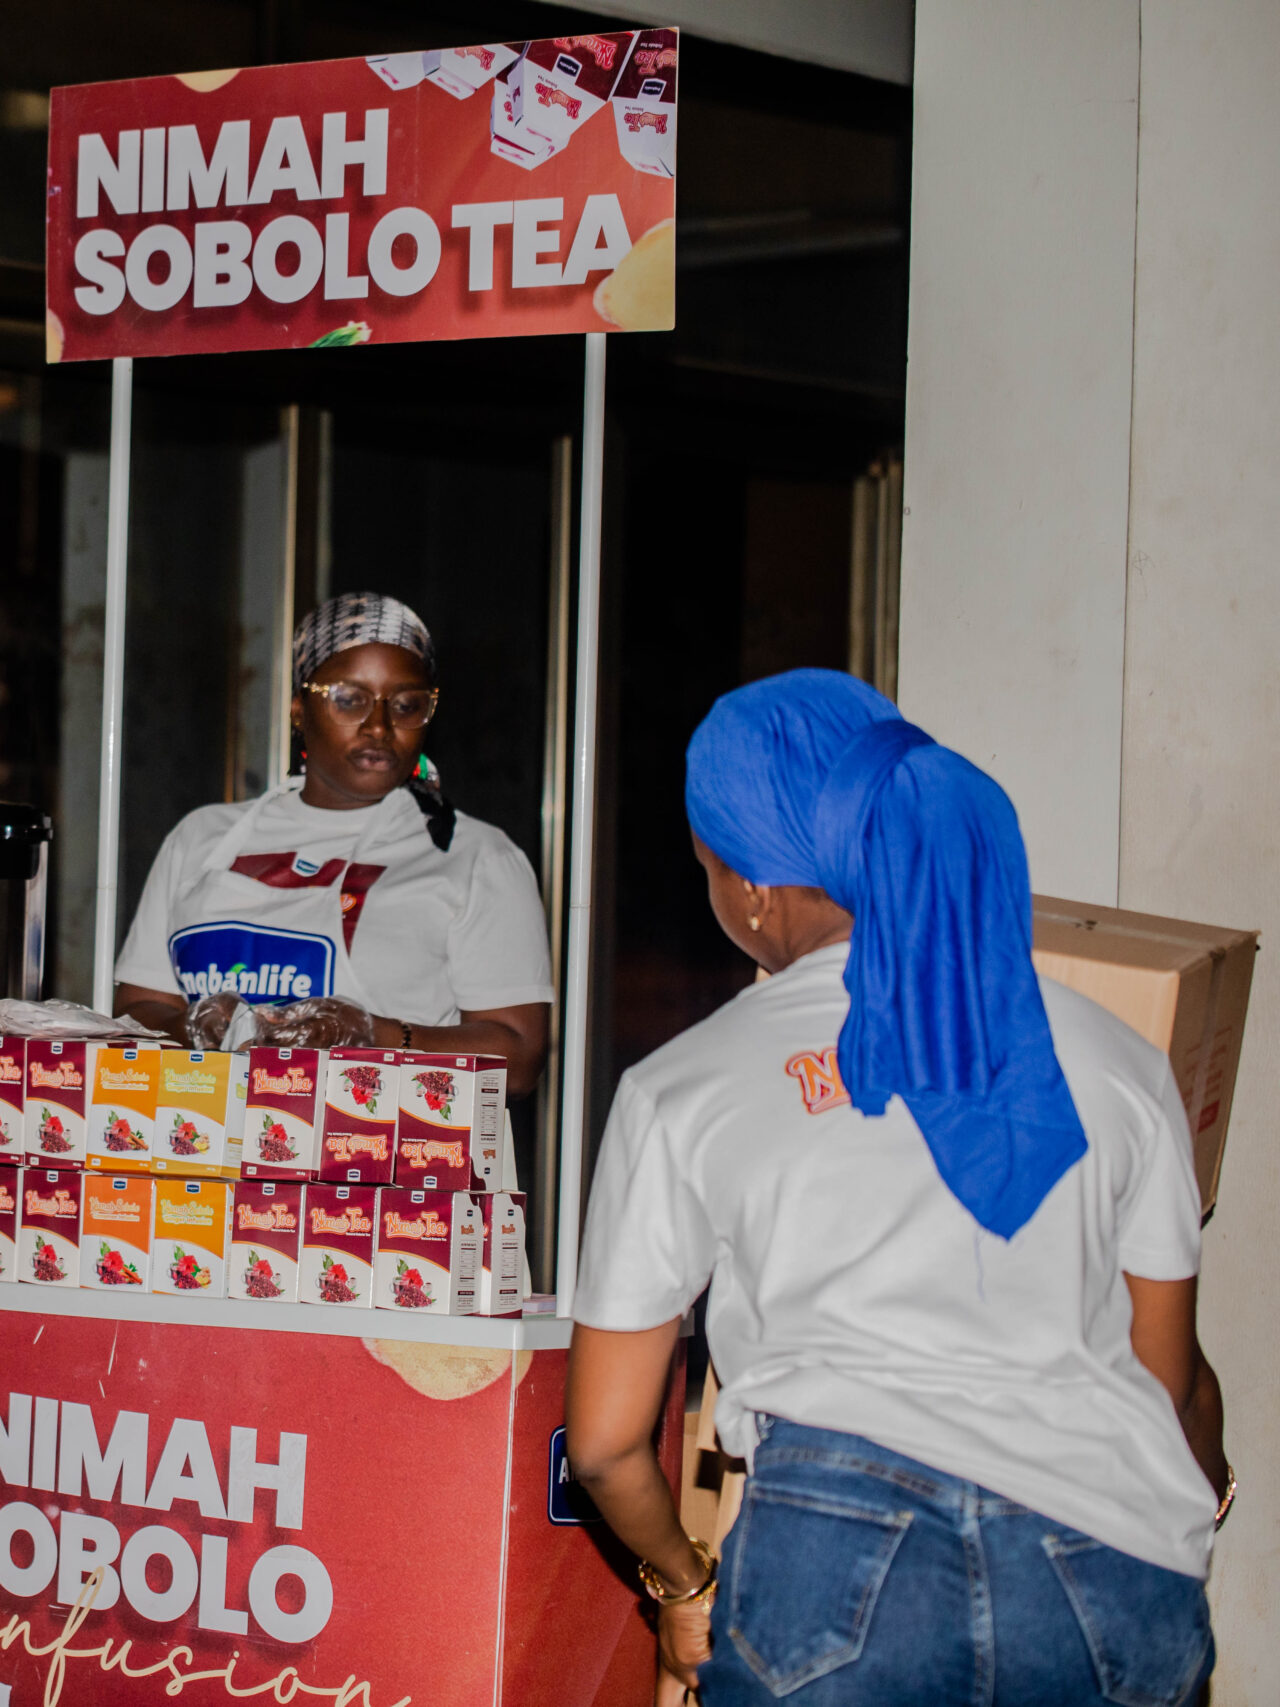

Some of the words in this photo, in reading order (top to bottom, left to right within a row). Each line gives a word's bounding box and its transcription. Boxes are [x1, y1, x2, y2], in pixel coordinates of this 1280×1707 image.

[76, 107, 389, 218] NIMAH
[74, 206, 442, 316] SOBOLO
[451, 193, 633, 292] TEA
[176, 963, 312, 998] ngbanlife
